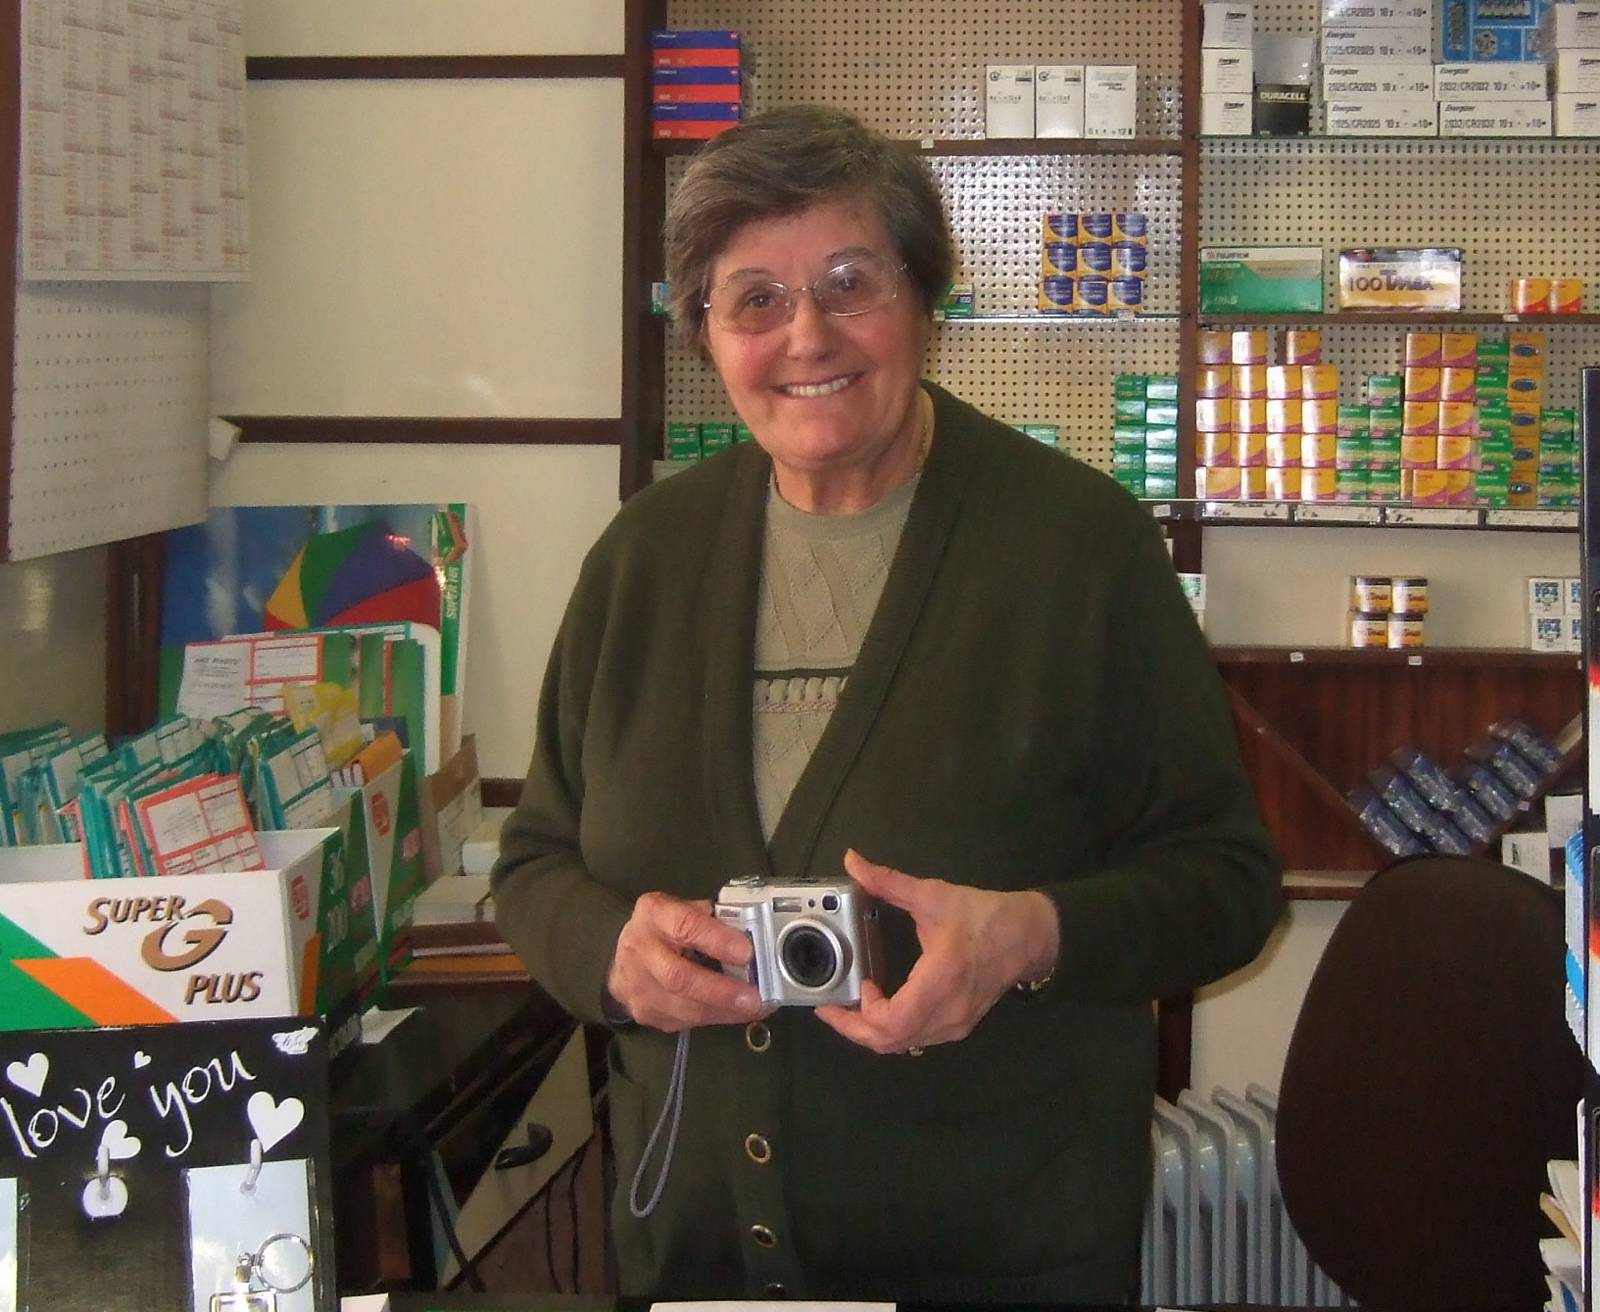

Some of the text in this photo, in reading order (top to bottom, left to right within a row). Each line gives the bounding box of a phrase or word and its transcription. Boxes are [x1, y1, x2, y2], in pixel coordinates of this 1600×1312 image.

[1329, 68, 1359, 76] Energizer
[1440, 67, 1470, 76] Energizer
[1260, 92, 1305, 100] DURACELL
[1332, 104, 1363, 114] Energizer
[1445, 104, 1476, 113] Energizer
[1350, 276, 1382, 292] 100
[83, 896, 187, 935] SUPER
[141, 899, 234, 972] G
[184, 971, 264, 1005] PLUS
[0, 1051, 257, 1158] love you
